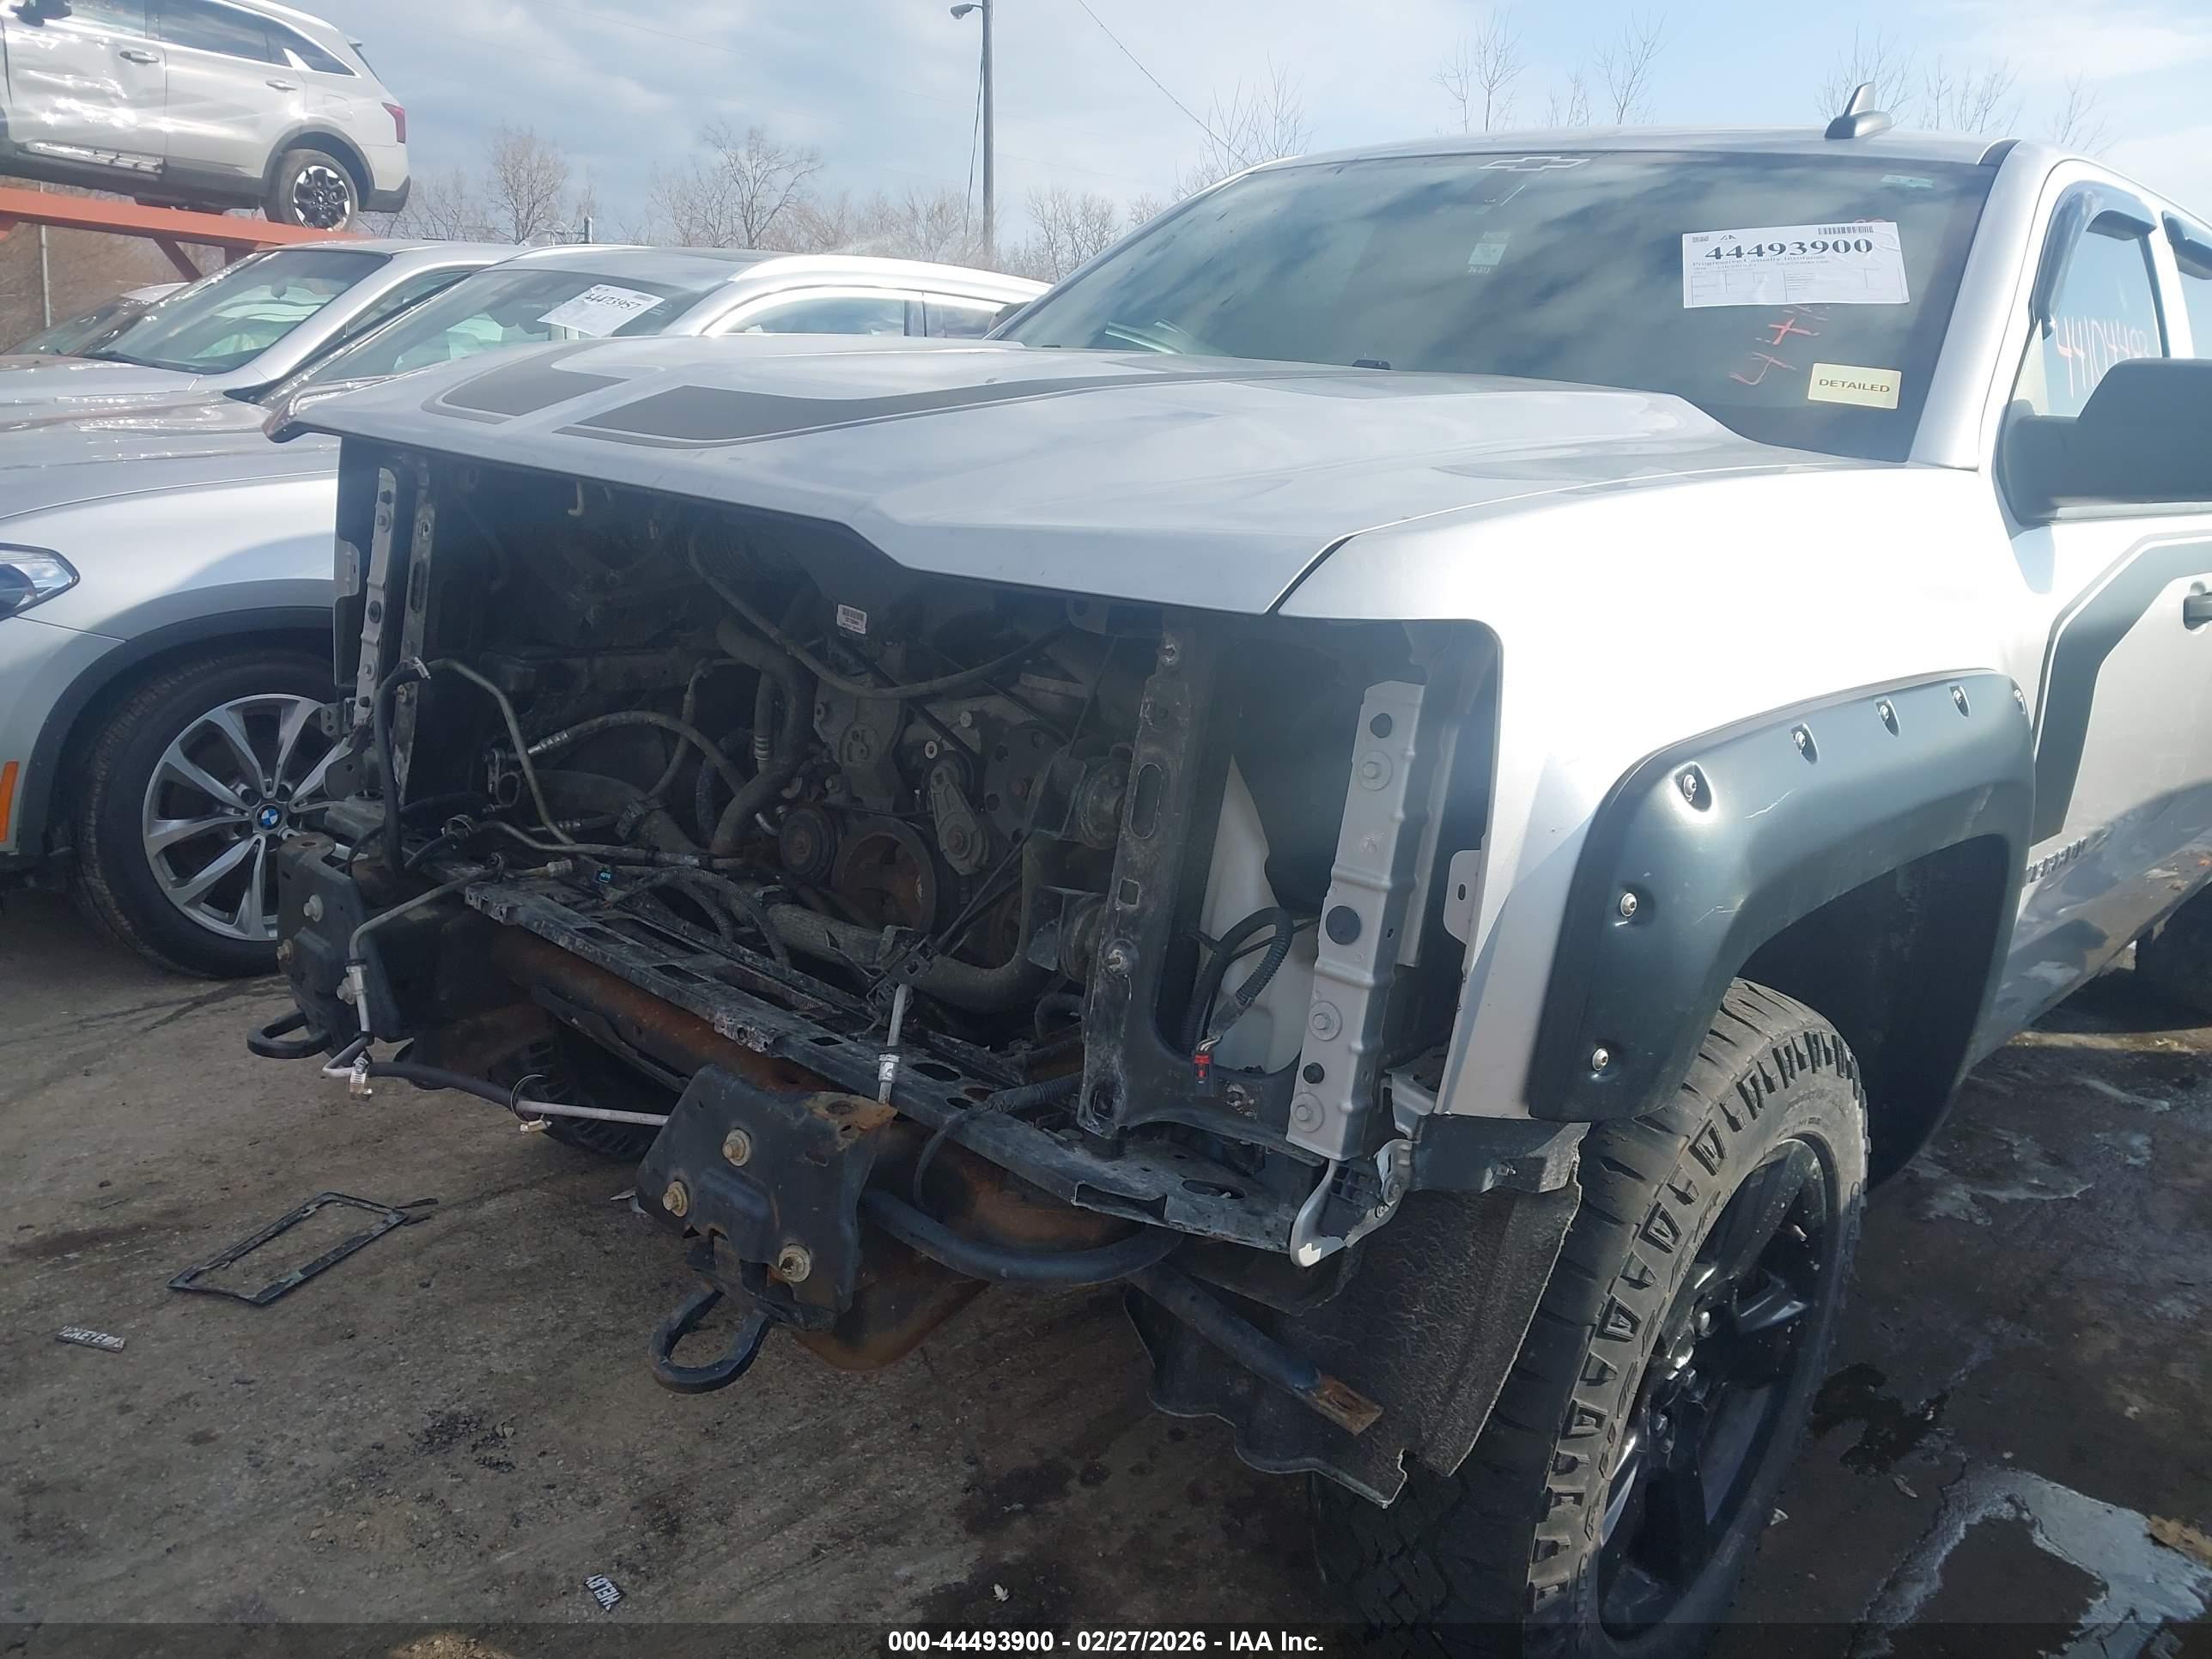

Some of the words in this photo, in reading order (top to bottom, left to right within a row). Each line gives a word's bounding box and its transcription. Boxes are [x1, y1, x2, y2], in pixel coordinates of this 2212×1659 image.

[1704, 238, 1874, 260] 44493900
[1818, 378, 1890, 393] DETAILED
[585, 1574, 622, 1610] HELBY
